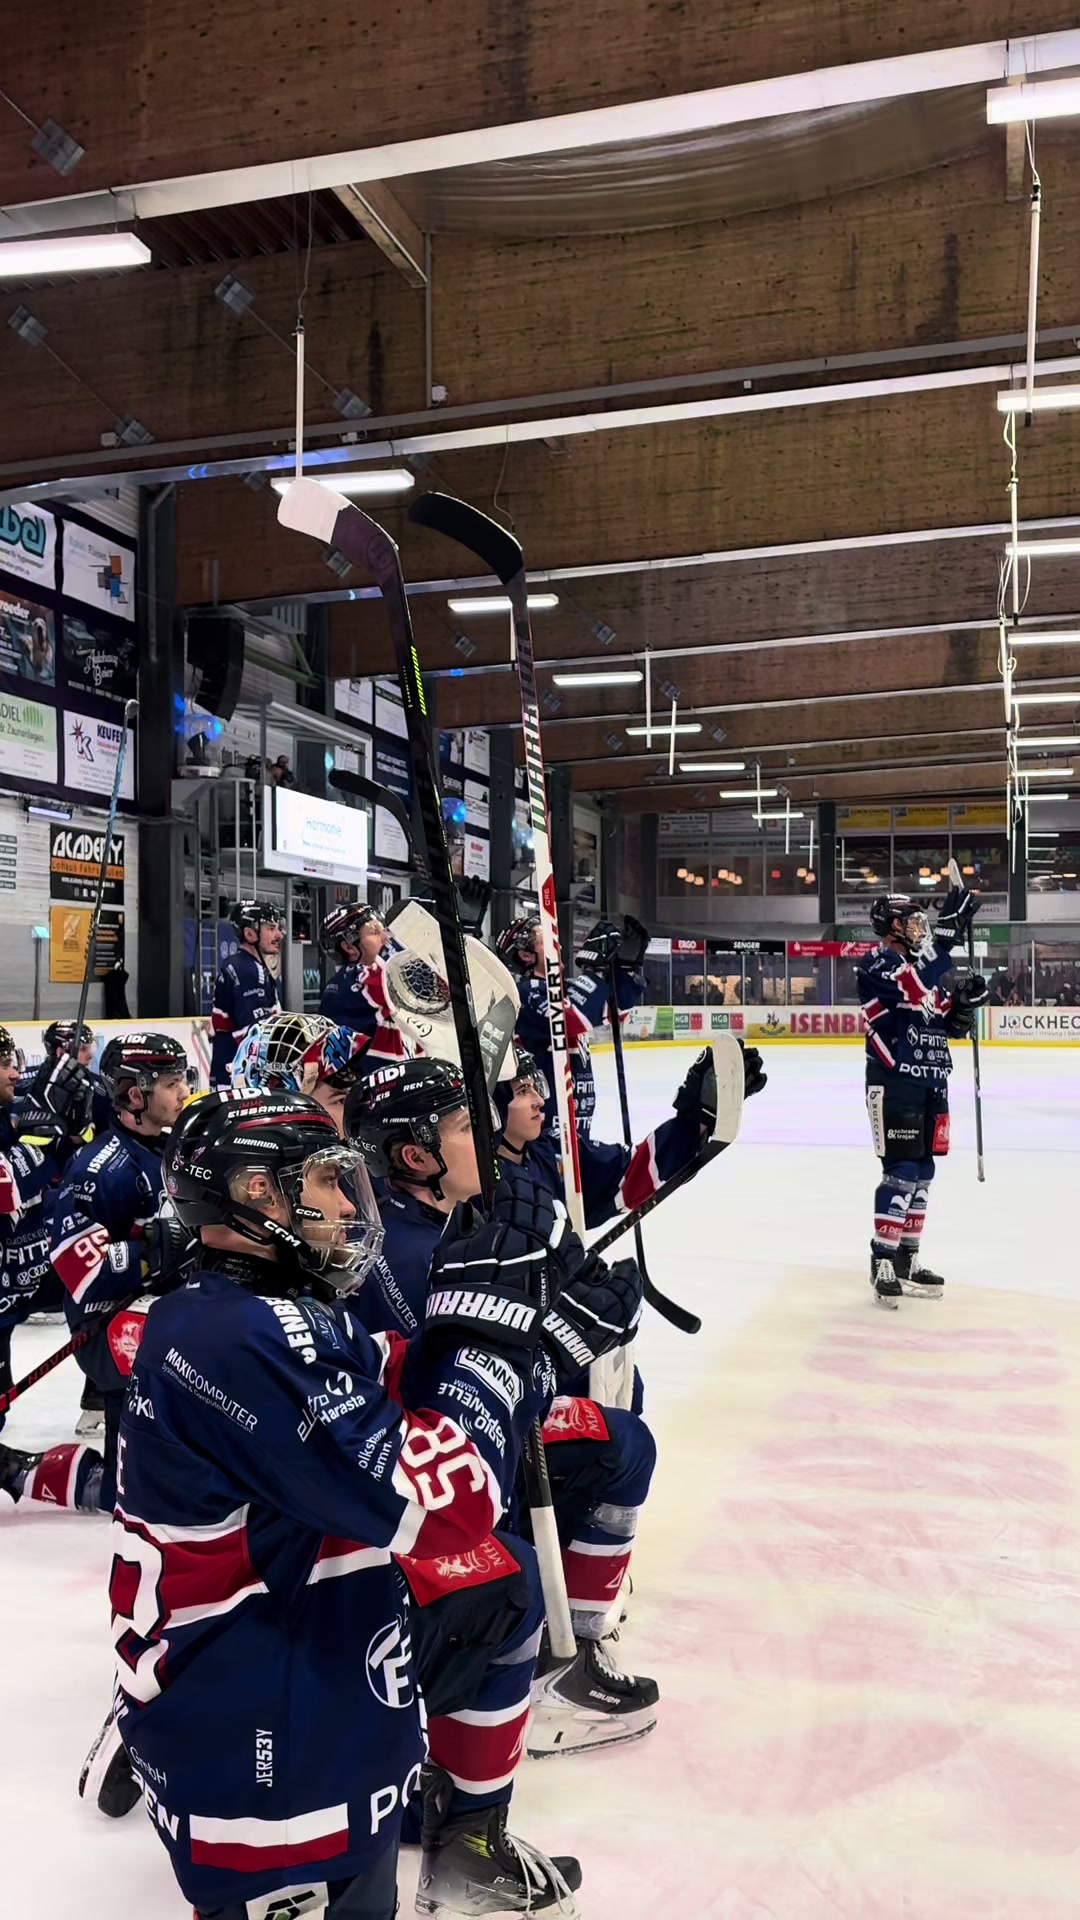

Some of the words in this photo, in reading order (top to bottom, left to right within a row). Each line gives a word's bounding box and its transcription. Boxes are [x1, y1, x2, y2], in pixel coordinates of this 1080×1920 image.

[678, 940, 697, 949] ERGO
[733, 941, 761, 949] SENGER
[546, 957, 566, 1051] COVERT
[295, 1207, 322, 1218] CCM
[263, 1220, 301, 1247] CCM
[376, 1255, 418, 1330] AXICOMPUTER
[165, 1347, 258, 1431] MAXICOMPUTER
[588, 1689, 621, 1705] BAUER
